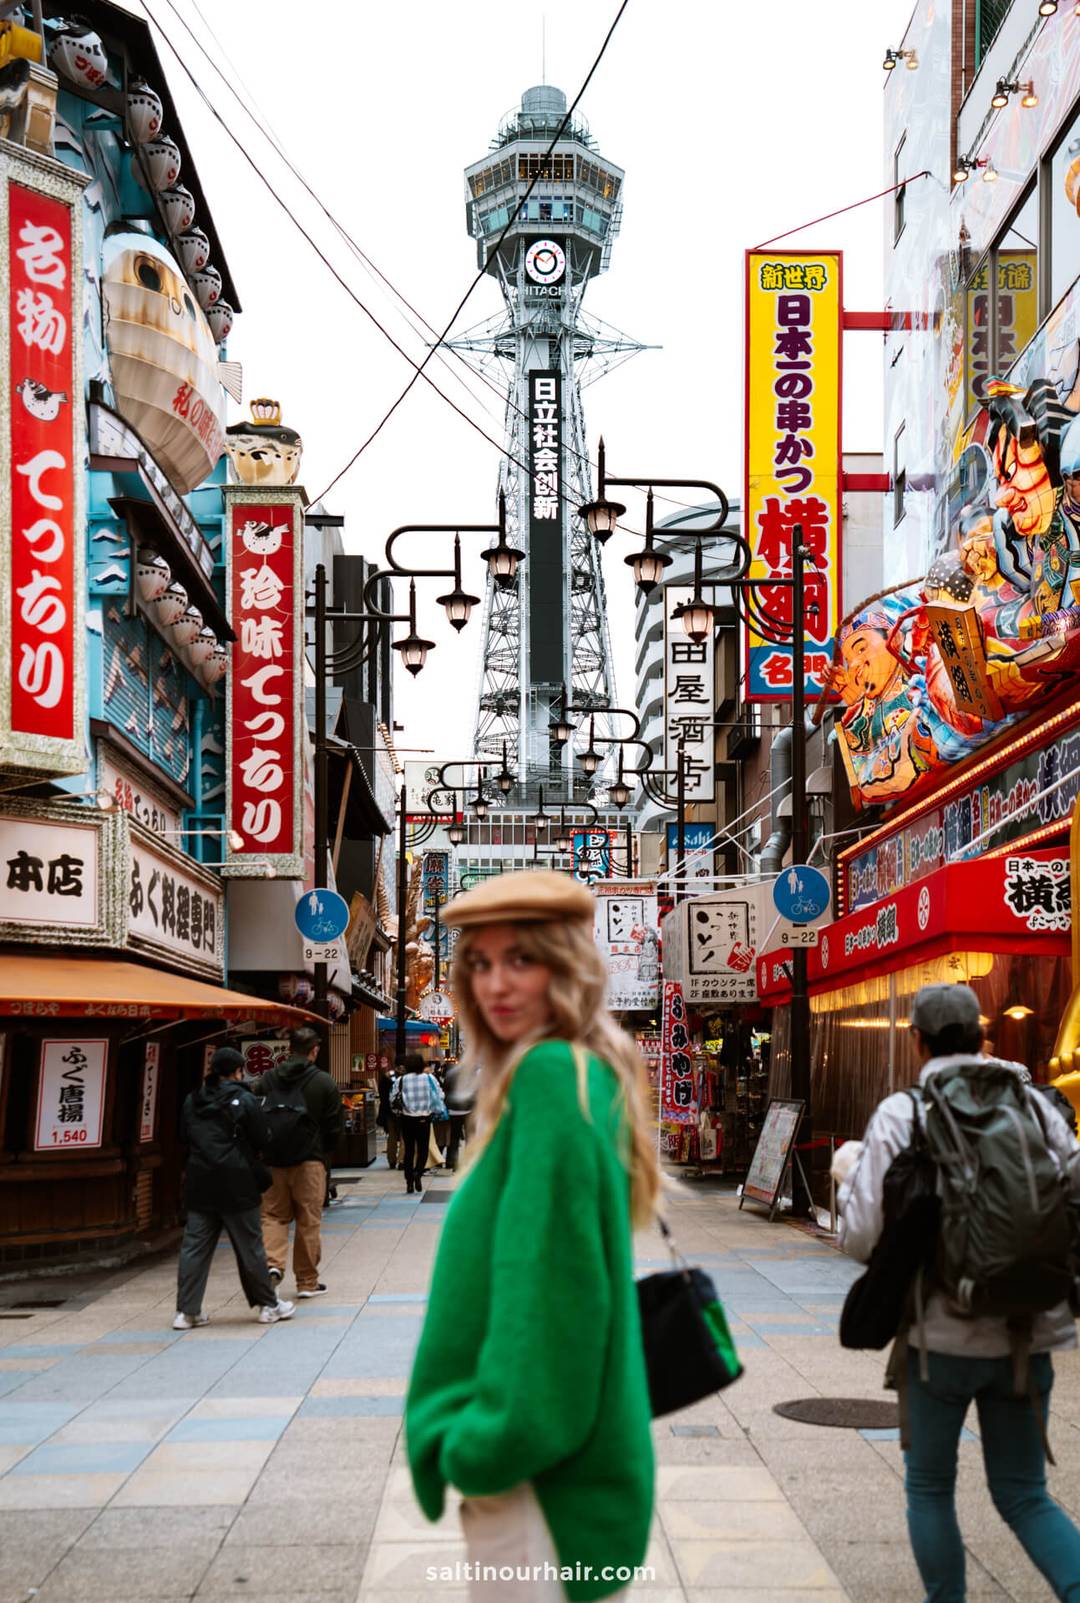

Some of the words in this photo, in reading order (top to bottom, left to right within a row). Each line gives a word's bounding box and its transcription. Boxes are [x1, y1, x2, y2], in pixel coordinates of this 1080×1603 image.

[761, 263, 827, 291] 新世界
[774, 294, 814, 494] 日本一の串かつ
[16, 450, 66, 709] てっちり
[757, 496, 829, 643] 横綱
[668, 597, 712, 792] 田屋酒店
[7, 850, 84, 897] 本店
[1008, 860, 1071, 873] 日本一の
[57, 1046, 88, 1123] ふぐ唐揚
